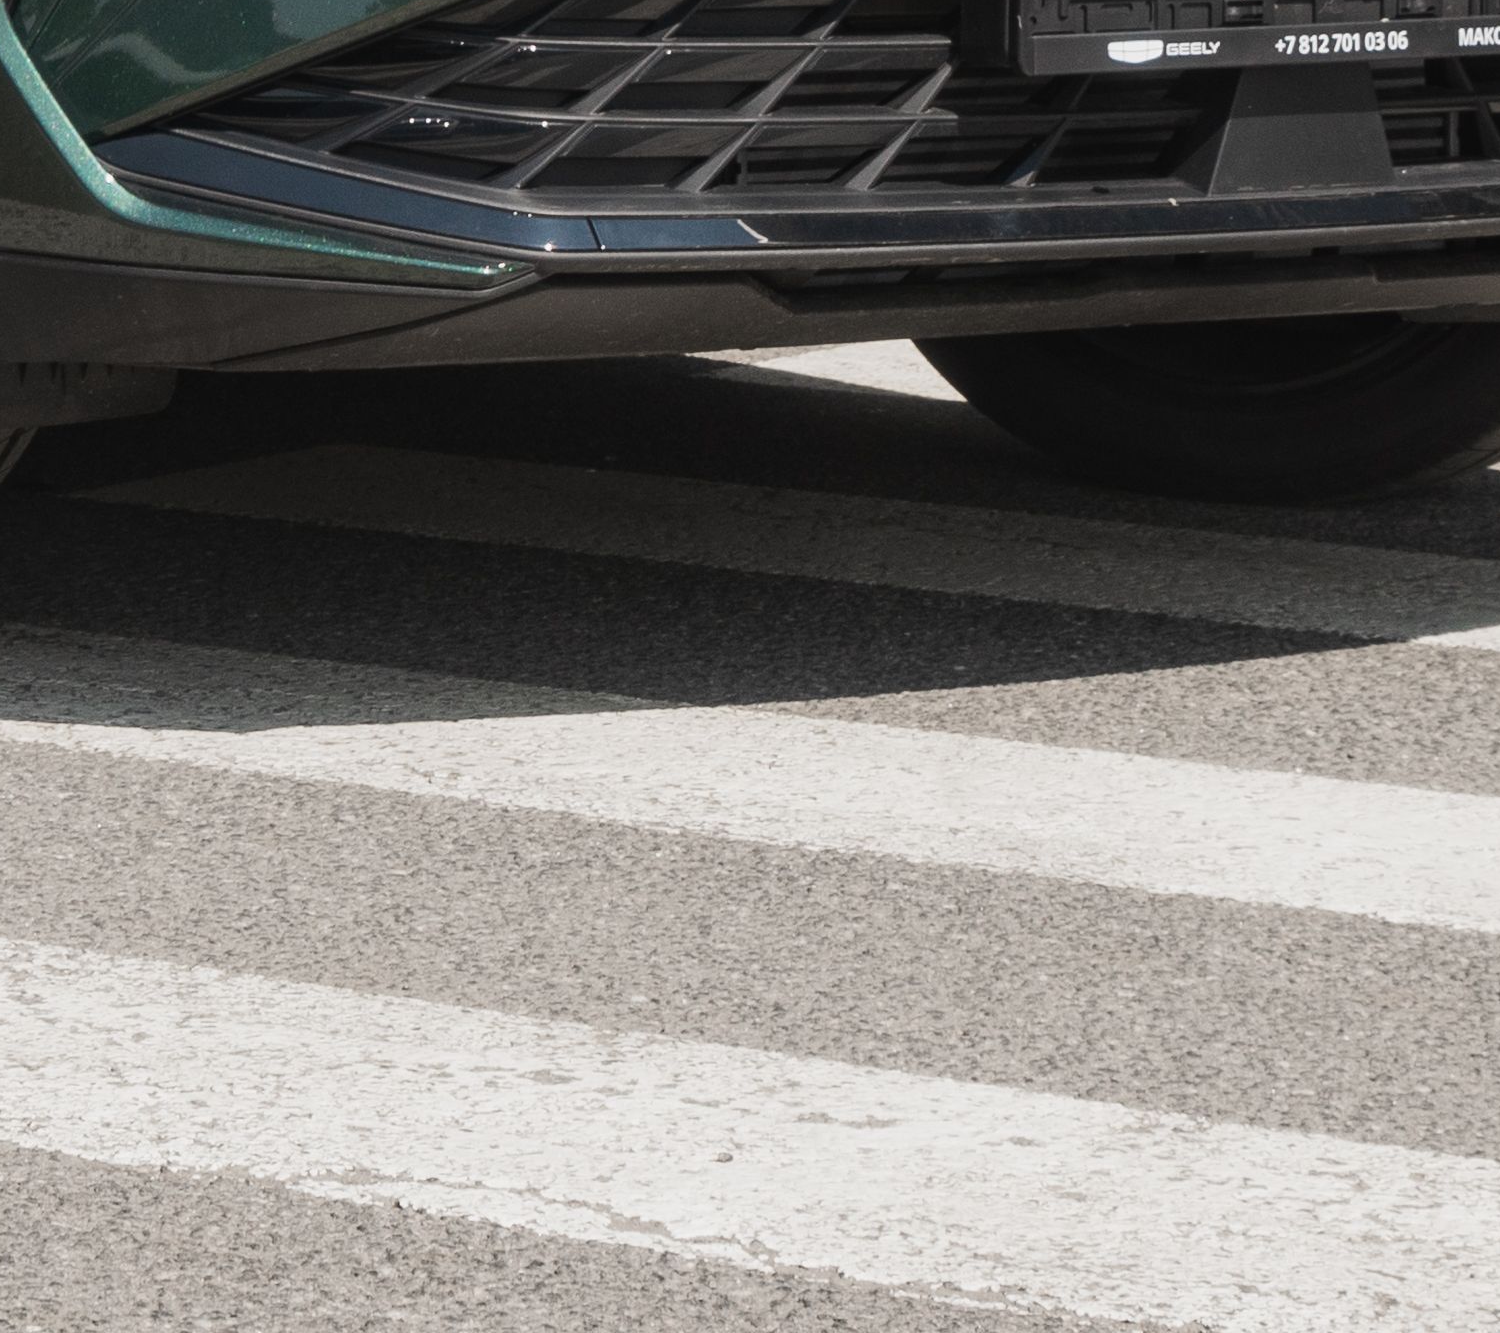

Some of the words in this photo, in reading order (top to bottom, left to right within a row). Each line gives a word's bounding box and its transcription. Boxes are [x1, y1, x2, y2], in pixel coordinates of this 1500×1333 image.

[1166, 41, 1221, 56] GEELY
[1275, 35, 1296, 54] +7
[1299, 34, 1329, 54] 812
[1332, 32, 1361, 53] 701
[1364, 31, 1386, 52] 03
[1388, 30, 1408, 51] 06
